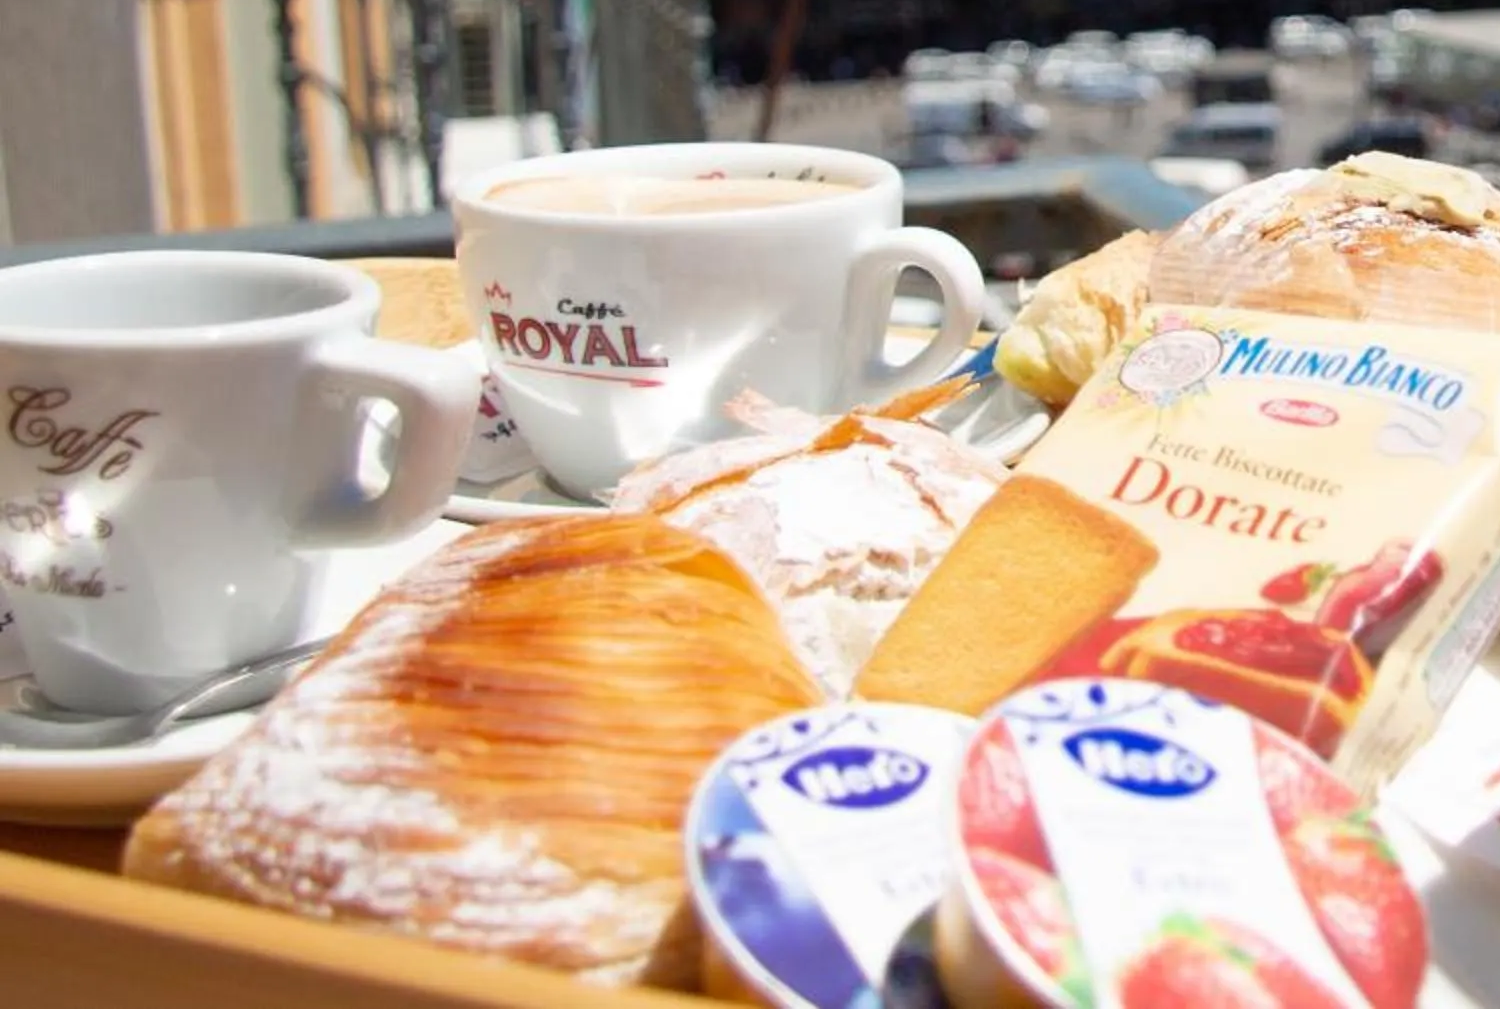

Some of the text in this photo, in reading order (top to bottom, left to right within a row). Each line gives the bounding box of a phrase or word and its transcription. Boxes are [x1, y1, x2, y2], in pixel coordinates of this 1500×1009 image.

[490, 311, 669, 368] ROYAL
[7, 385, 162, 481] Caffè
[1148, 432, 1344, 498] Fette Biscottate
[1110, 455, 1328, 543] Dorate
